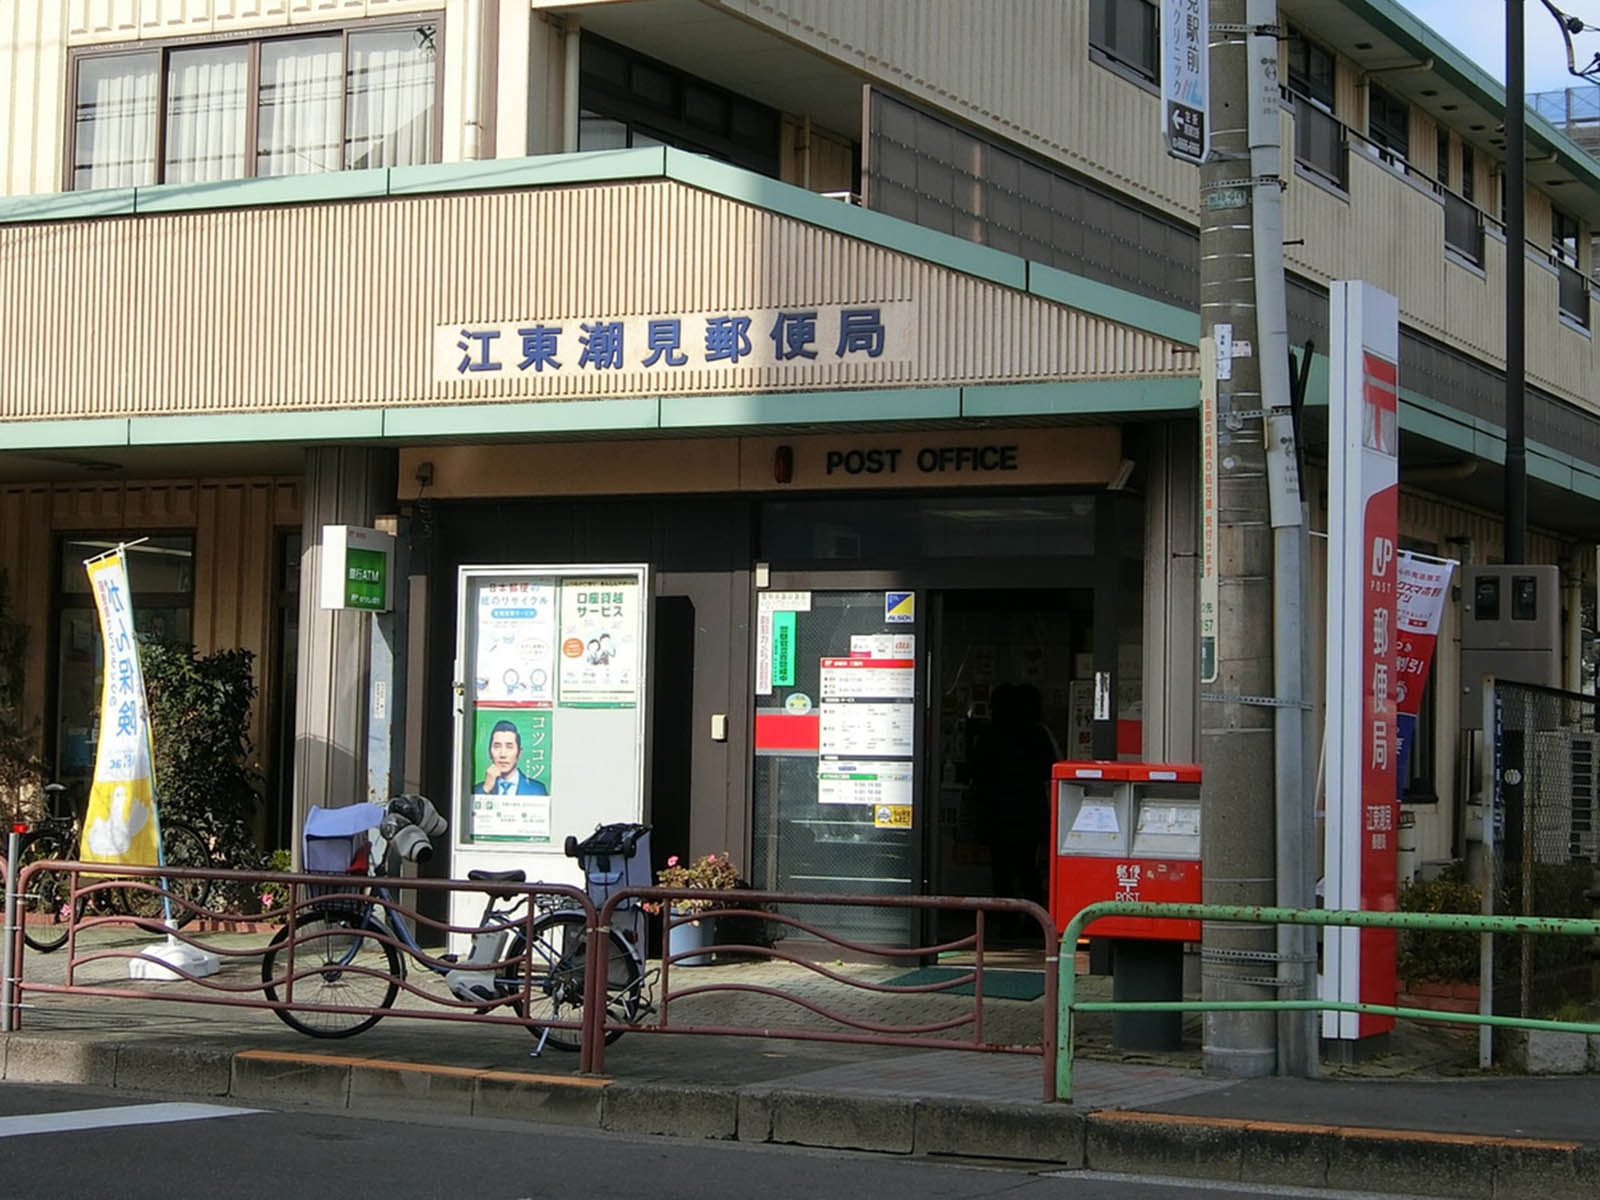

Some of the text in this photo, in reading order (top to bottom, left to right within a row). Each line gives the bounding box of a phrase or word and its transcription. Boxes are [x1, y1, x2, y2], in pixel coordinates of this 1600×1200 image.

[457, 308, 885, 373] 江東潮見郵便局
[826, 446, 1018, 475] POST OFFICE
[1370, 582, 1392, 593] POST
[577, 606, 624, 618] サービス
[1372, 607, 1389, 770] 郵便局
[531, 716, 546, 780] コツコツ
[1116, 864, 1141, 880] 郵便
[1115, 892, 1140, 902] POST
